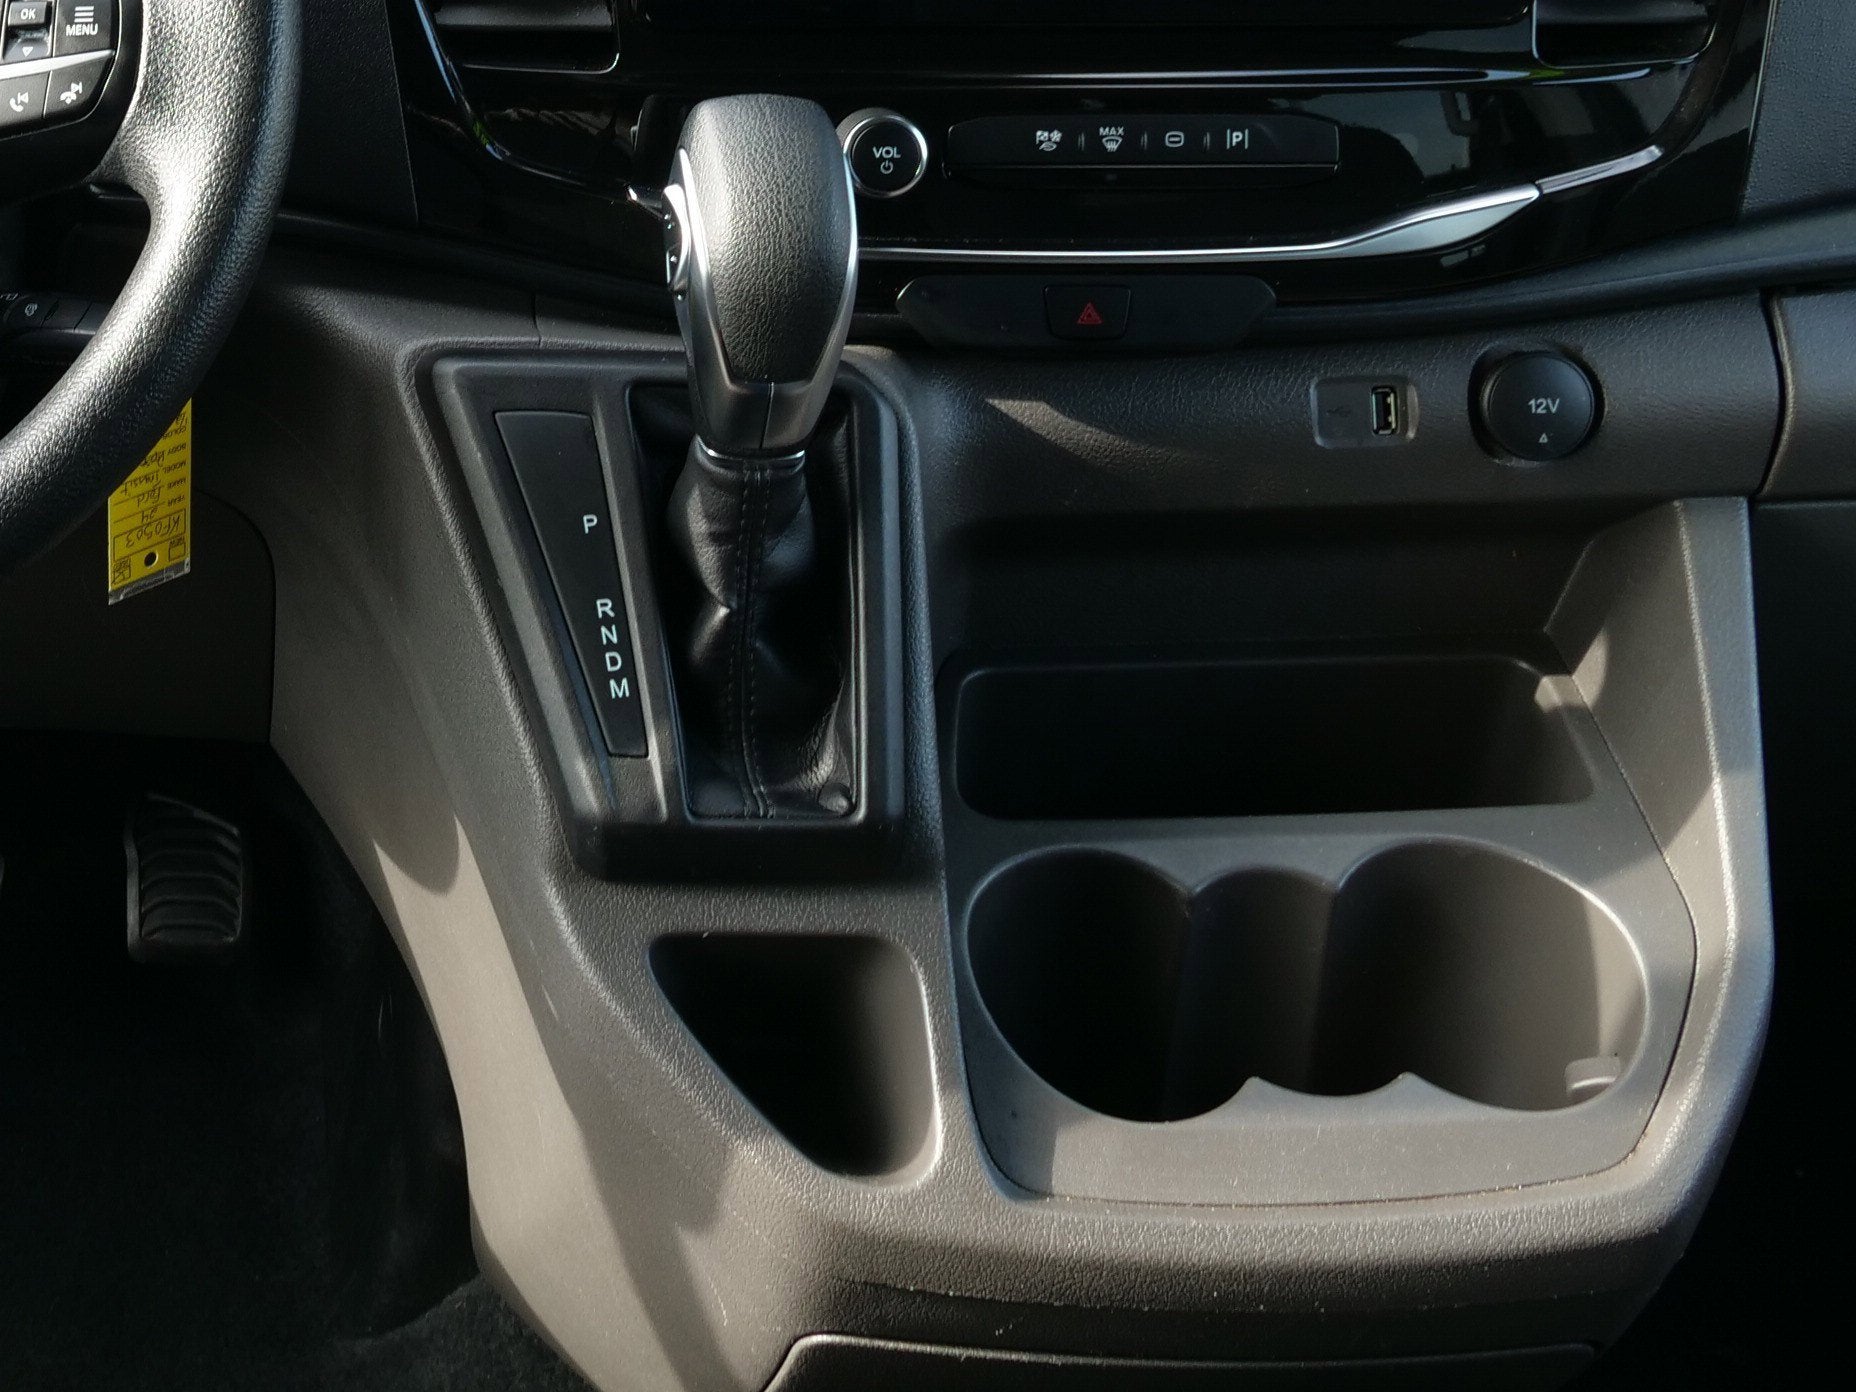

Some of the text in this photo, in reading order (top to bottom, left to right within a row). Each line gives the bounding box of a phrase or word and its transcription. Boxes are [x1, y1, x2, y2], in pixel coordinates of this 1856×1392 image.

[20, 9, 36, 20] OK
[65, 23, 99, 37] MENU
[1099, 126, 1125, 137] MAX
[872, 146, 902, 159] VOL
[1527, 398, 1560, 414] 12V
[582, 514, 598, 534] P
[596, 598, 615, 618] R
[600, 624, 618, 645] N
[605, 651, 622, 672] D
[609, 677, 630, 699] M
